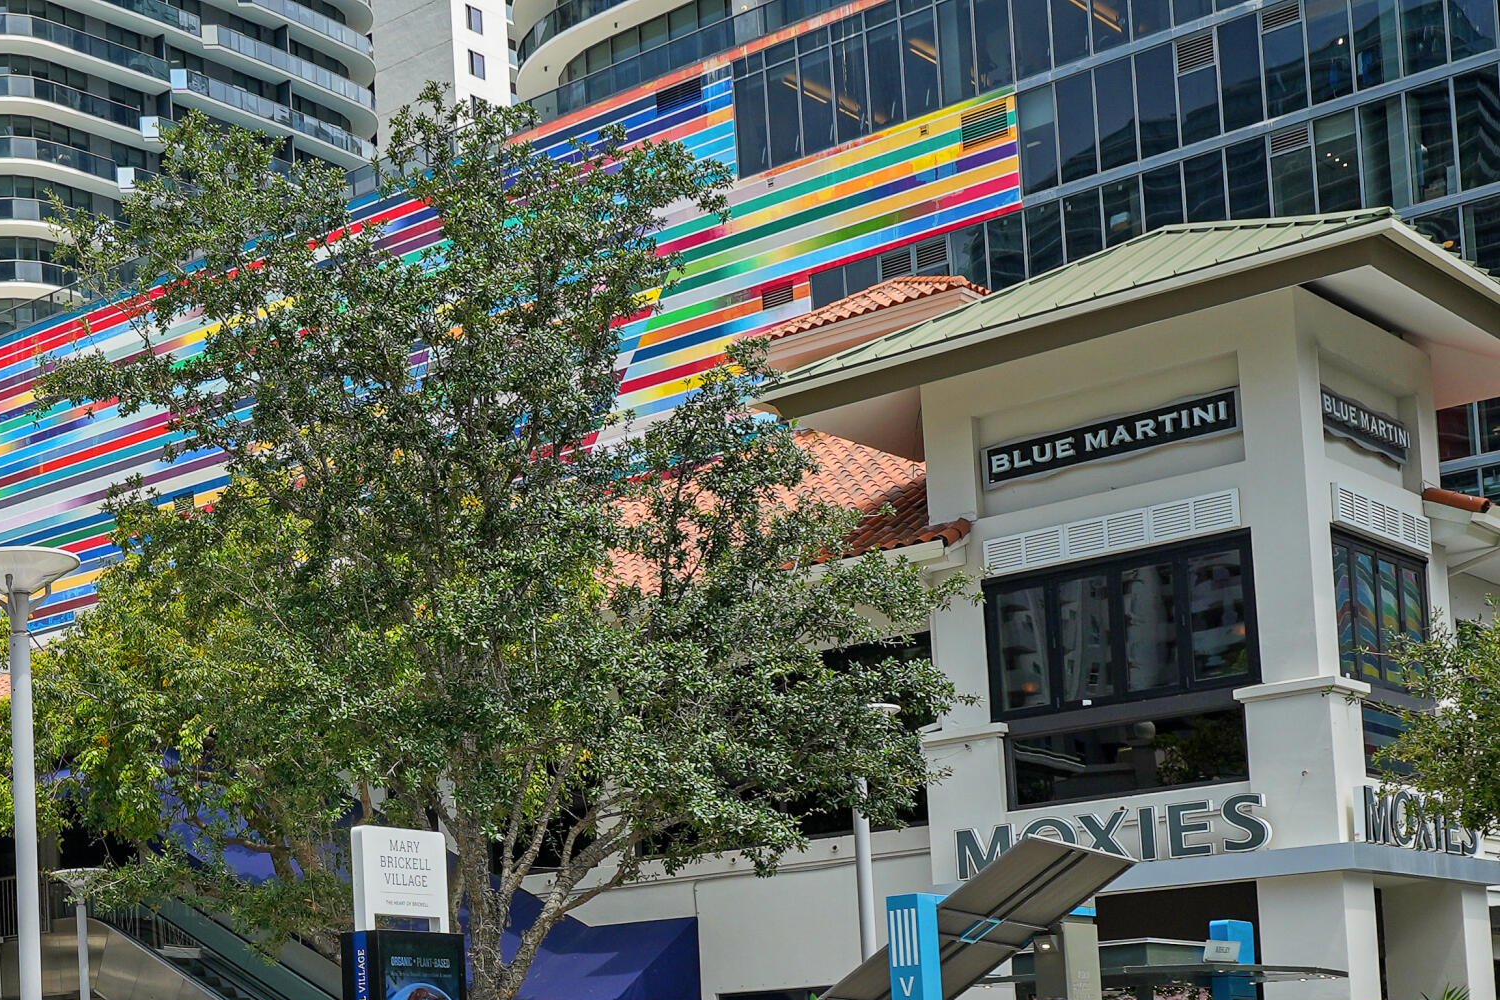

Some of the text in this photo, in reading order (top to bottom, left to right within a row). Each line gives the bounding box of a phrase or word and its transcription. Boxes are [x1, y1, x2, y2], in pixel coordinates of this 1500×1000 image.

[1322, 392, 1411, 449] BLUE MARTINI
[990, 400, 1228, 474] BLUE MARTINI
[389, 839, 420, 854] MARY
[379, 855, 431, 871] BRICKELL
[383, 872, 428, 888] VILLAGE
[357, 949, 366, 993] VILLAGE
